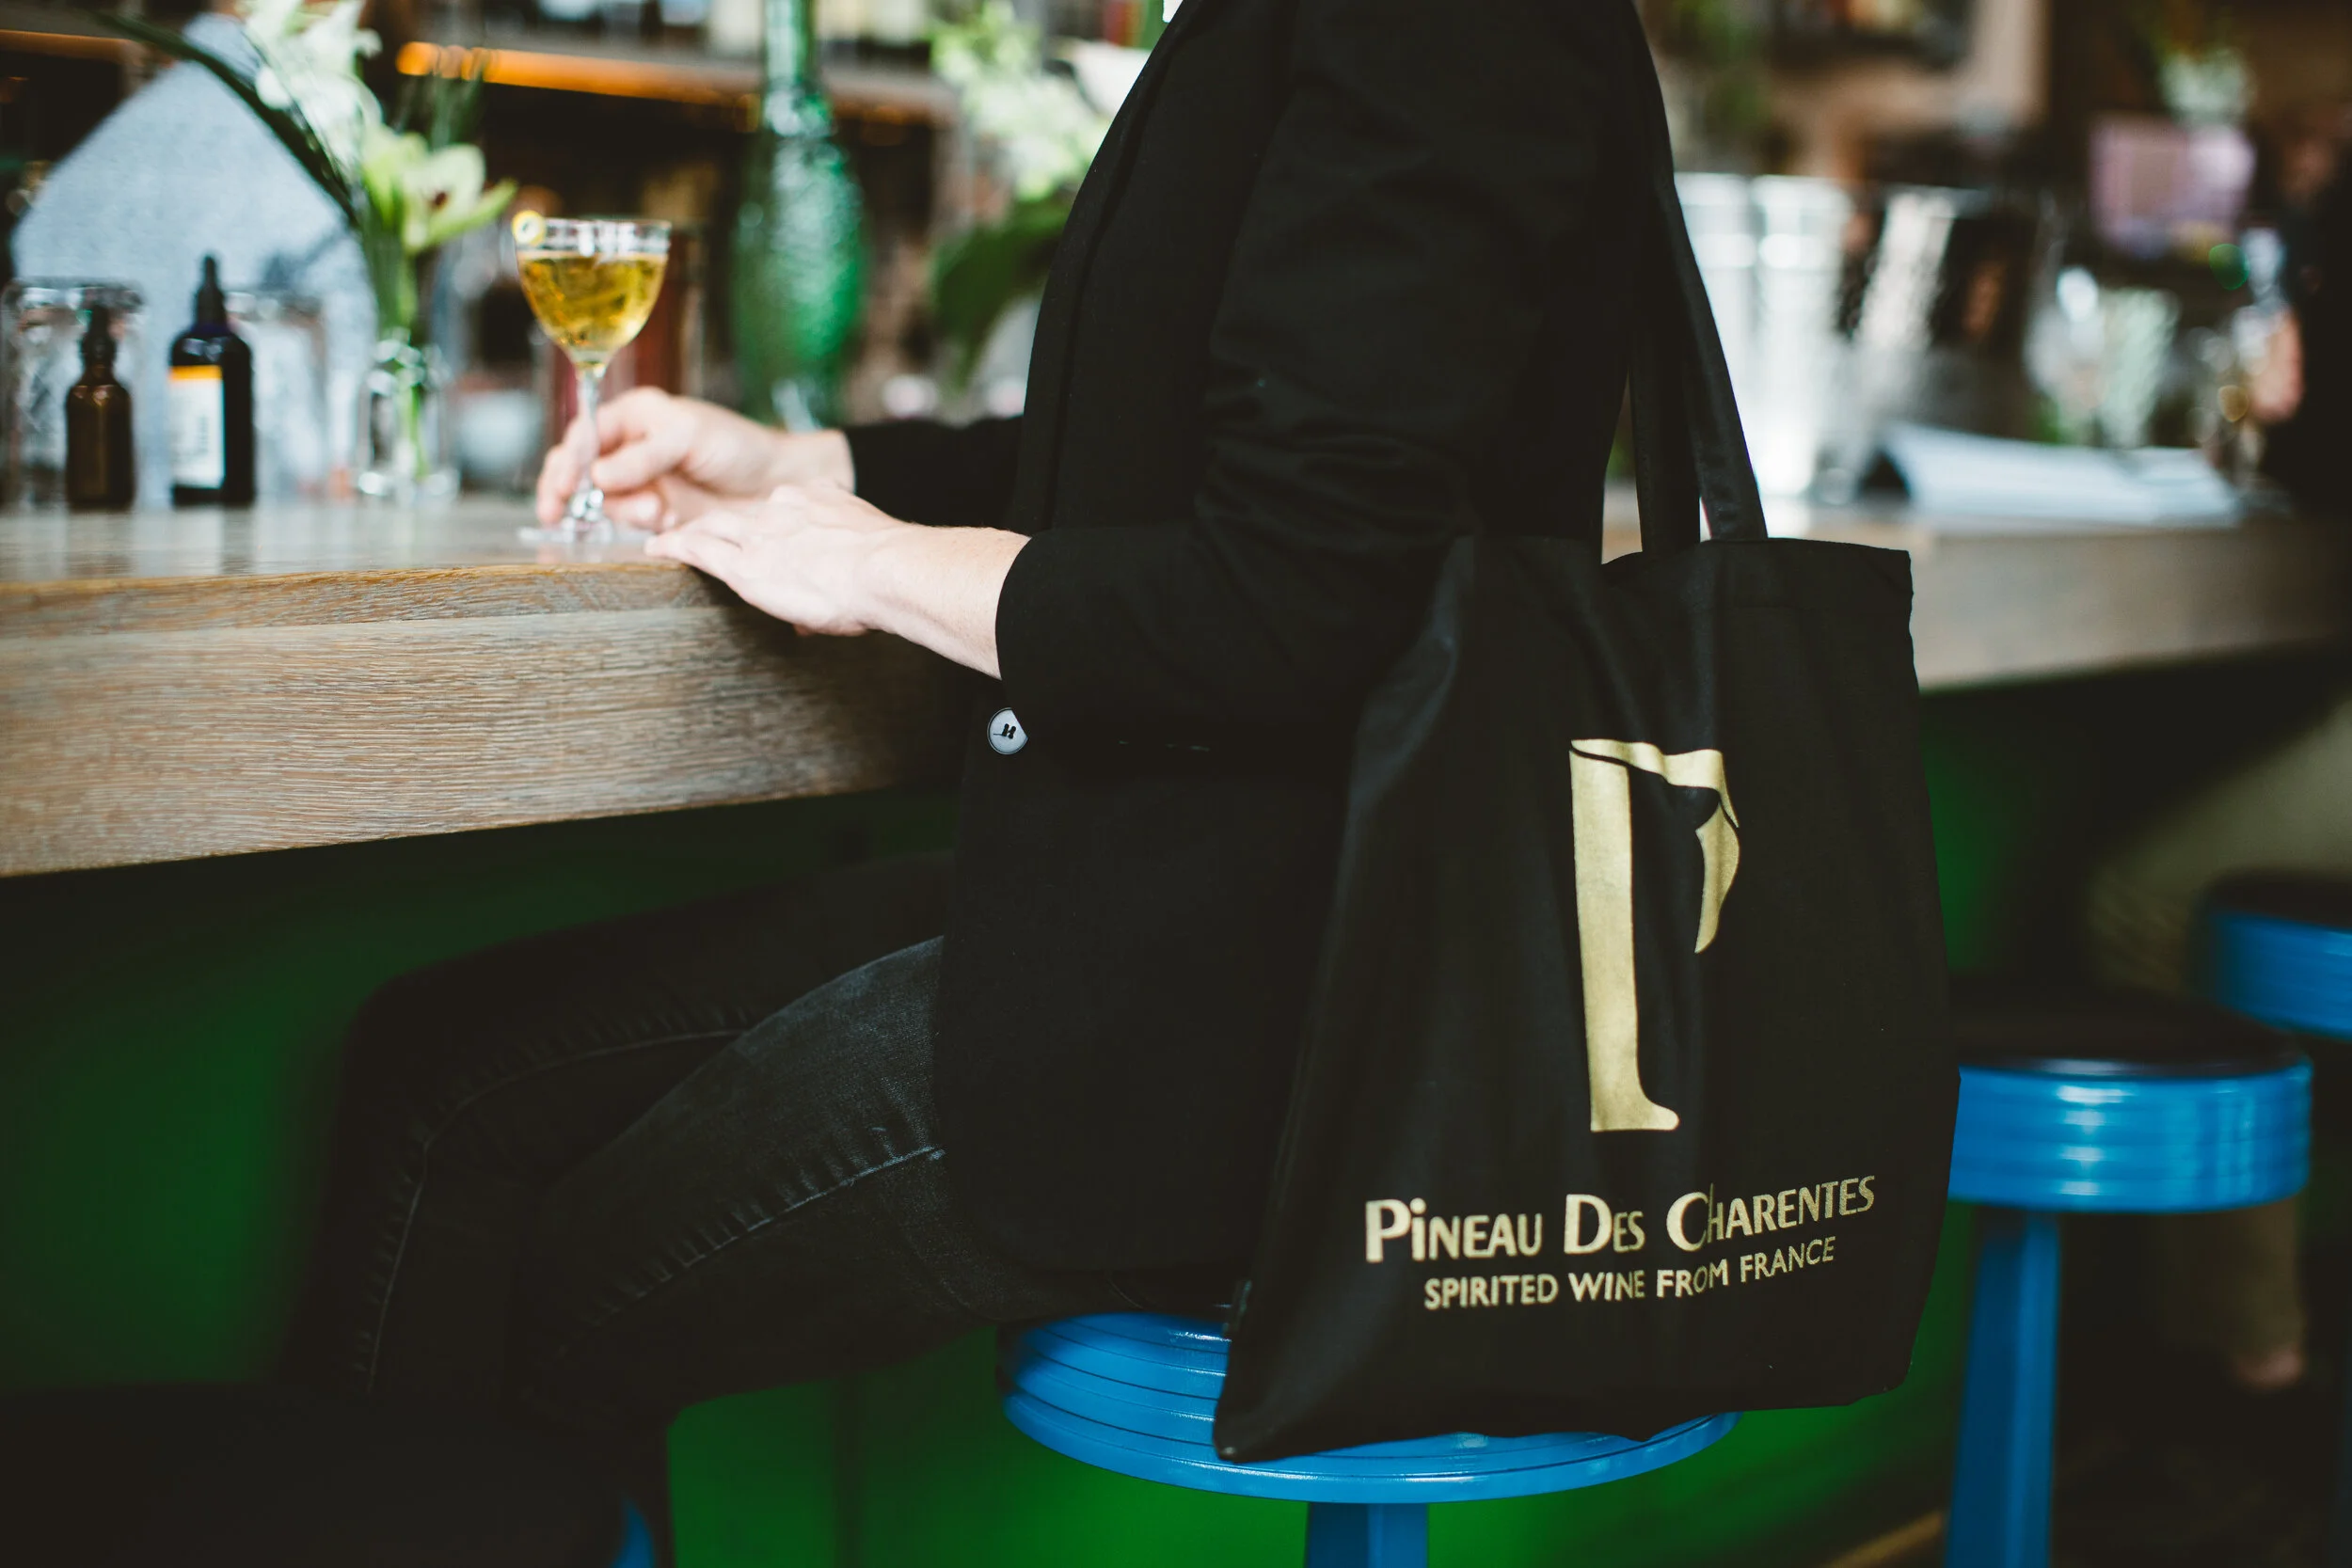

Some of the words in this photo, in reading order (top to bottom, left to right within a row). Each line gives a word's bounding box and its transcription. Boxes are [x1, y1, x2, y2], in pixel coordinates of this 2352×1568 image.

[1563, 1193, 1645, 1255] DES
[1423, 1273, 1560, 1310] SPIRITED
[1567, 1269, 1645, 1303] WINE
[1656, 1258, 1729, 1298] FROM
[1740, 1235, 1836, 1283] FRANCE
